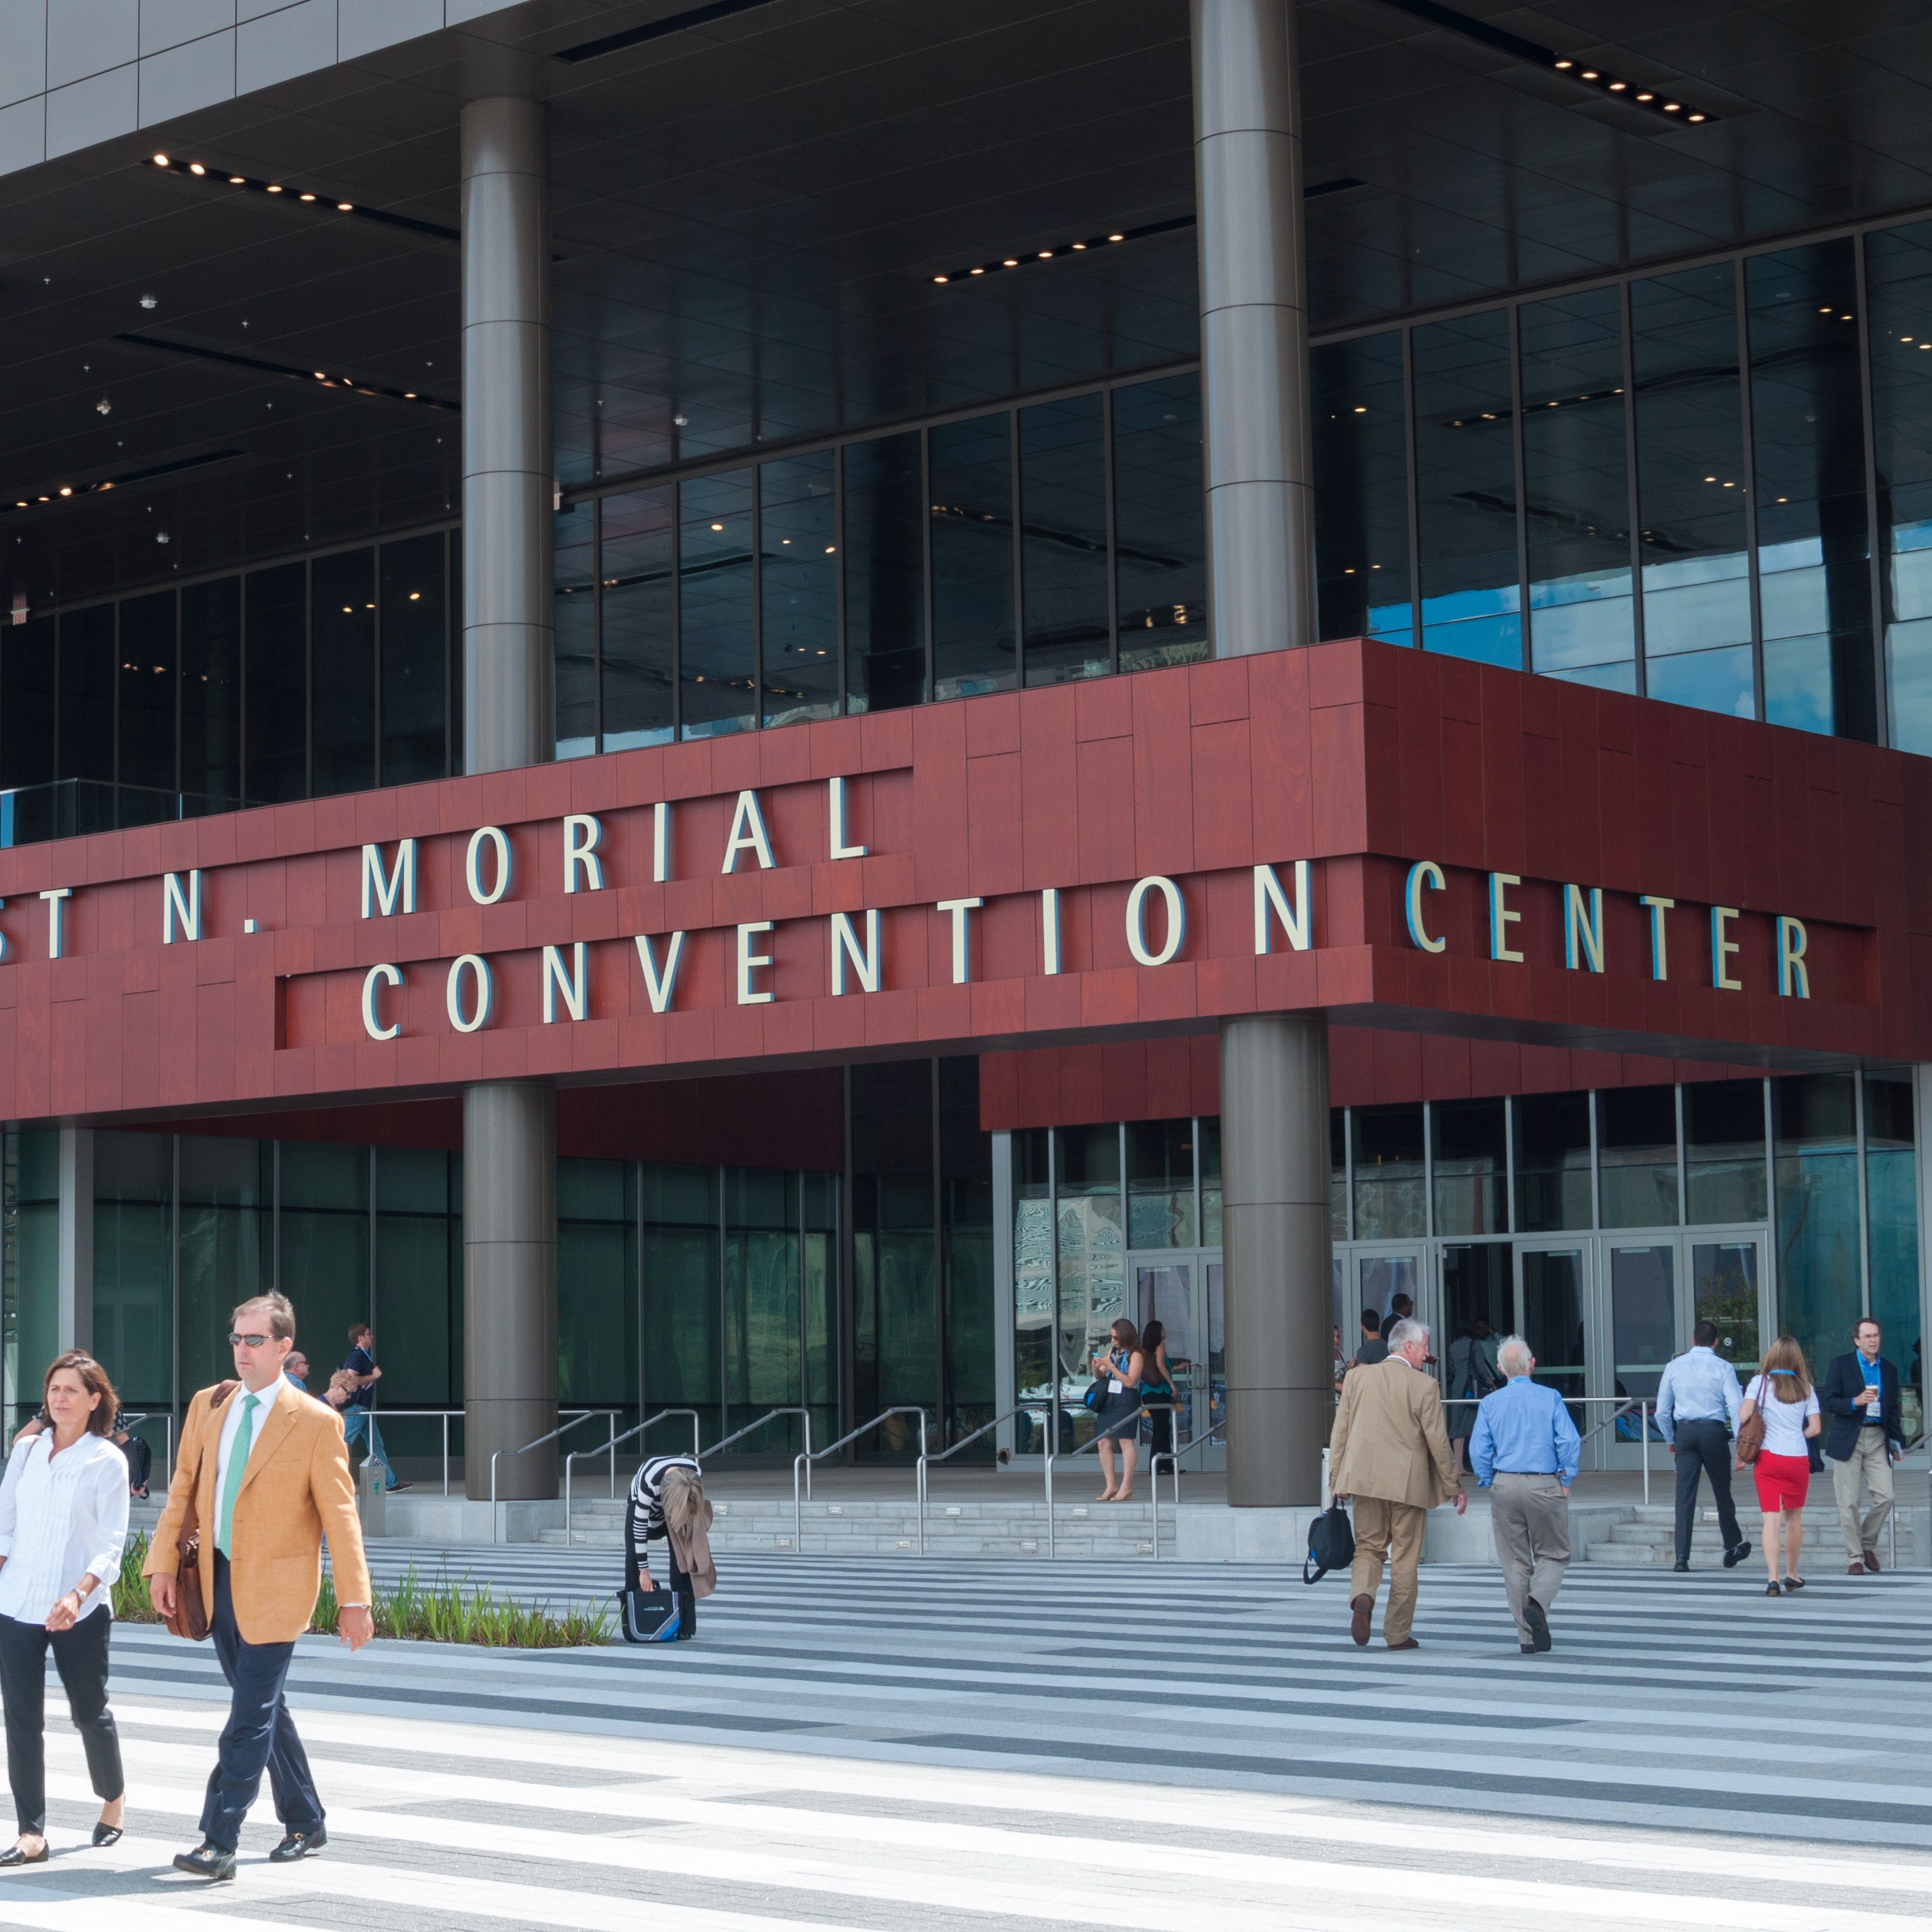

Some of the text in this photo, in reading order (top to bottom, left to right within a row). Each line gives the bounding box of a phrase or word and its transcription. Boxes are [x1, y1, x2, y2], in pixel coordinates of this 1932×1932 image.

[0, 888, 73, 965] T
[361, 776, 868, 919] MORIAL
[361, 859, 1312, 1041] CONVENTION
[1405, 861, 1811, 999] CENTER
